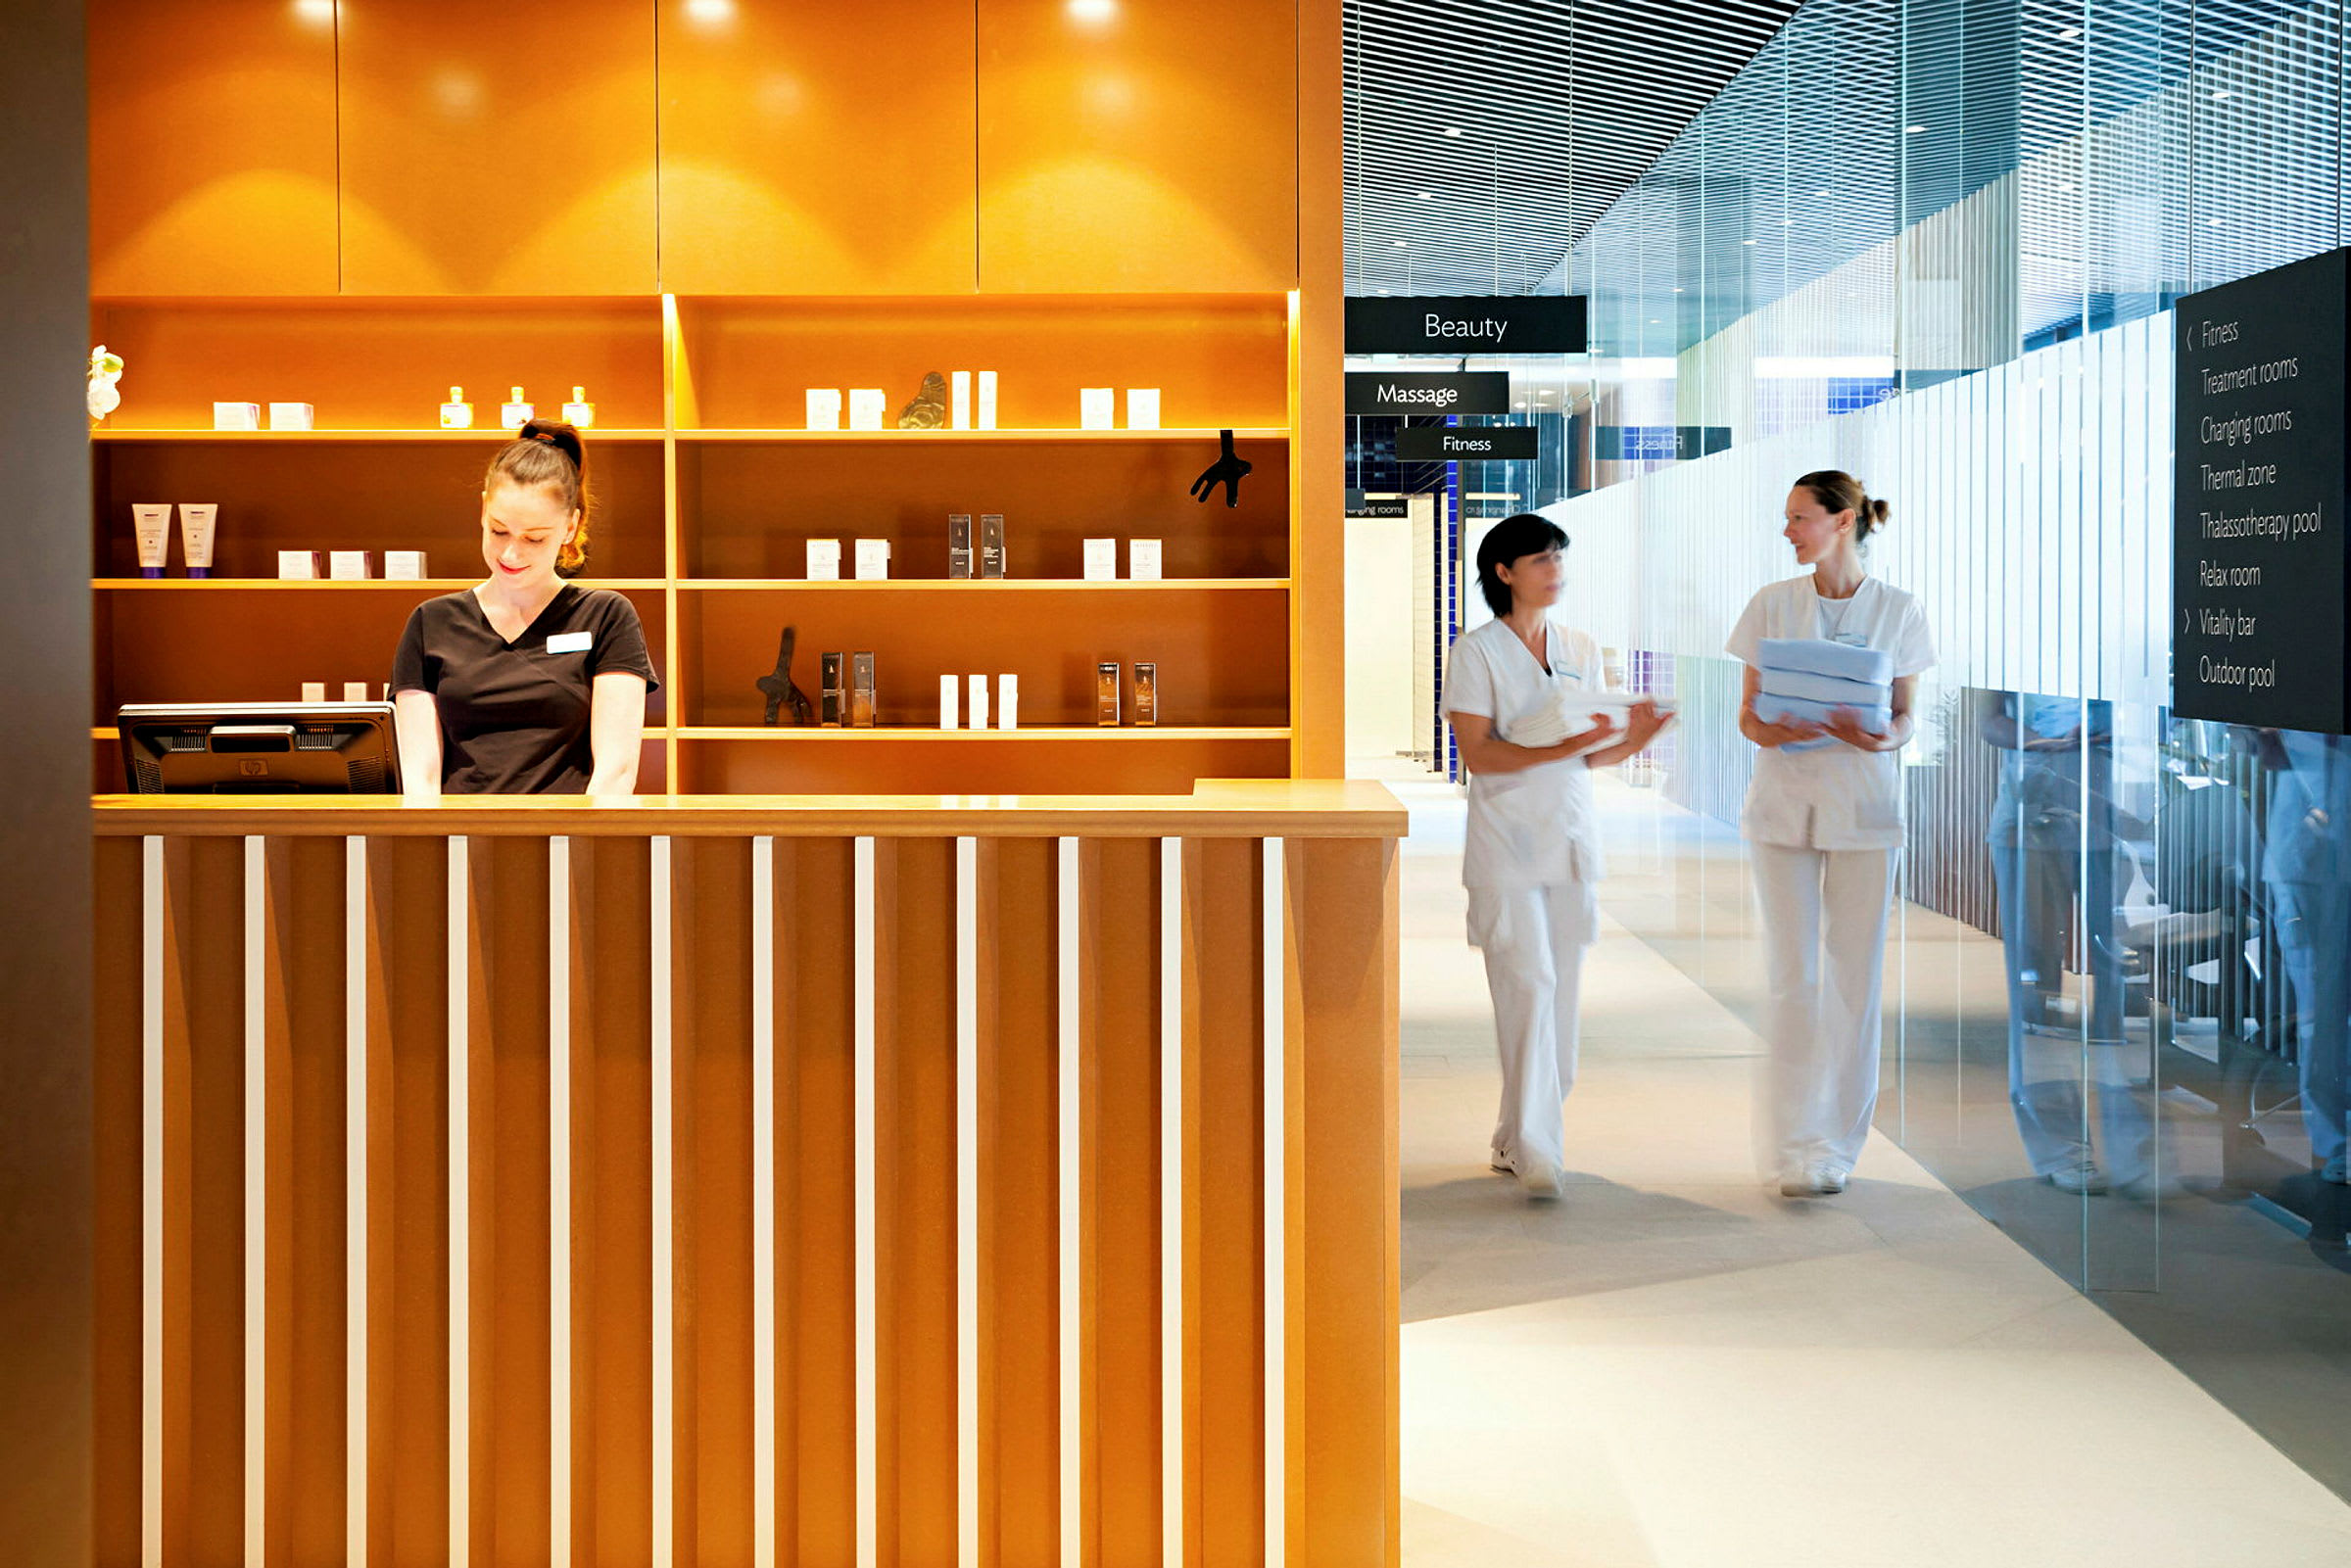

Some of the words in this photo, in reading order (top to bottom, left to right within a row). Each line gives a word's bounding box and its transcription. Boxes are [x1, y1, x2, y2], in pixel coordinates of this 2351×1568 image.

[1425, 313, 1508, 343] Beauty
[2202, 320, 2239, 348] Fitness
[2201, 364, 2257, 395] Treatment
[2259, 357, 2298, 383] rooms
[1376, 384, 1458, 407] Massage
[1443, 436, 1491, 451] Fitness
[2201, 411, 2252, 447] Changing
[2254, 410, 2292, 434] rooms
[2200, 459, 2245, 491] Thermal
[2247, 463, 2277, 486] zone
[2200, 508, 2290, 542] Thalassotherapy
[2293, 502, 2322, 541] pool
[2200, 559, 2228, 587] Relax
[2231, 566, 2261, 586] room
[2199, 608, 2235, 642] Vitality
[2237, 608, 2256, 636] bar
[2199, 655, 2246, 685] Outdoor
[2248, 659, 2275, 693] pool
